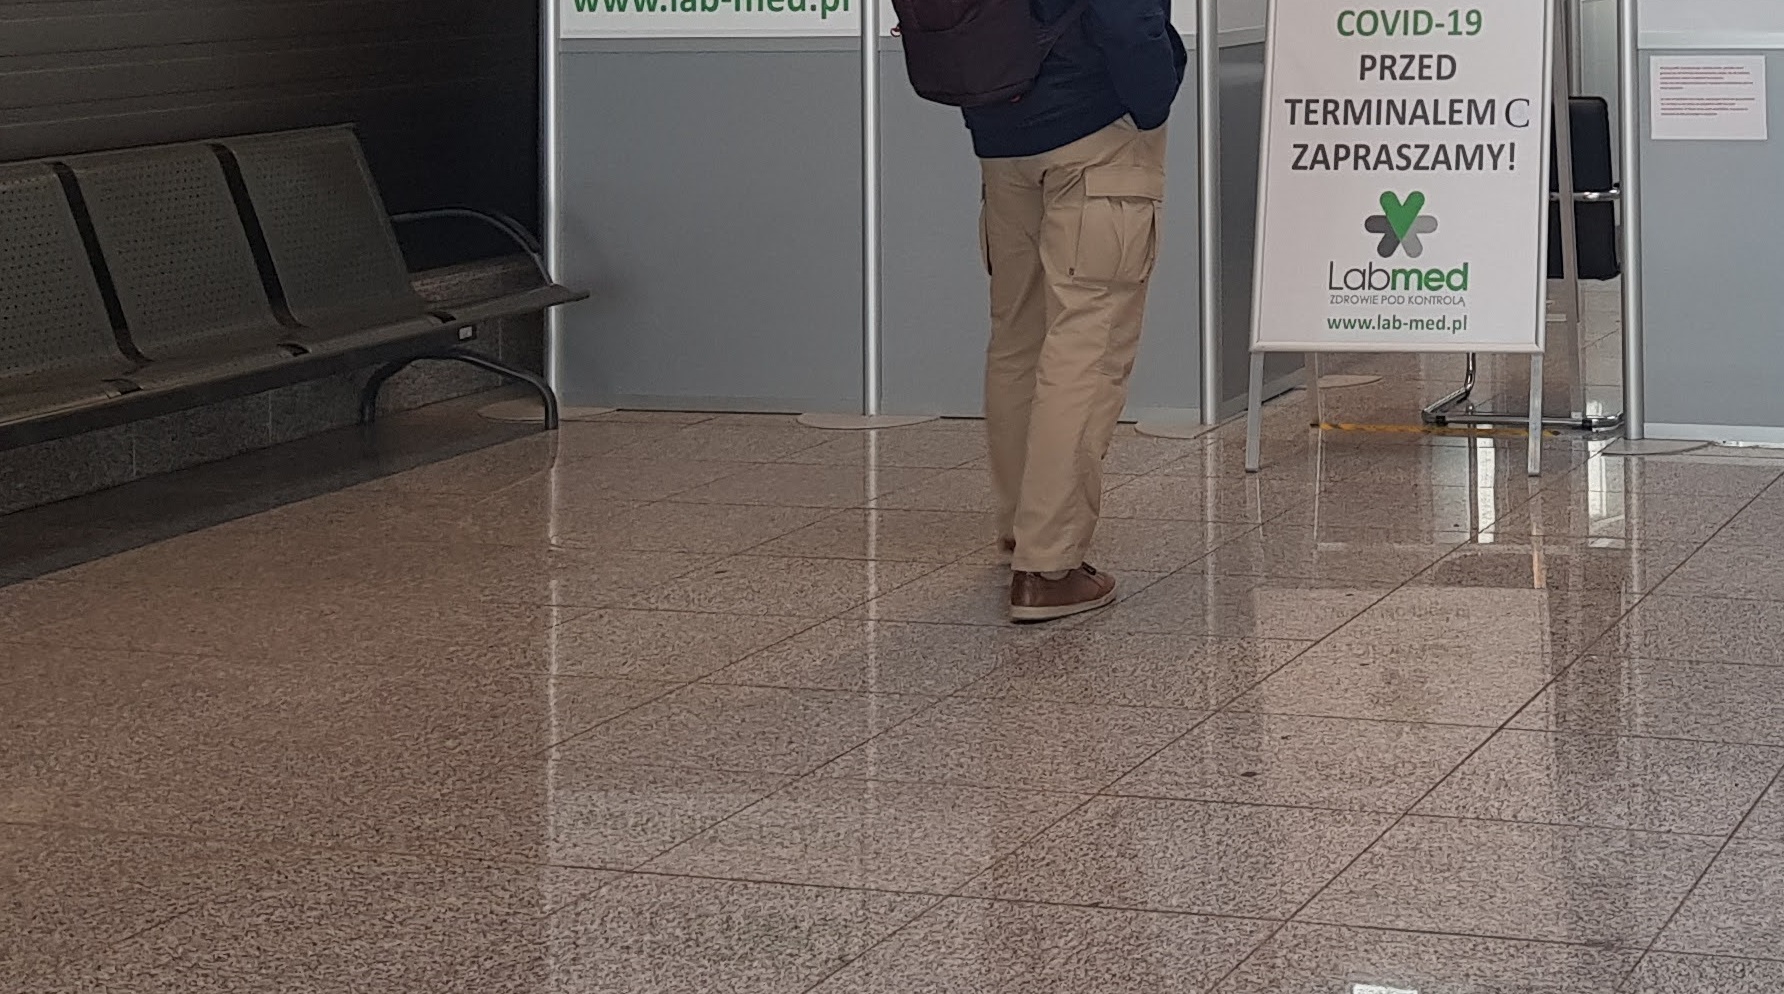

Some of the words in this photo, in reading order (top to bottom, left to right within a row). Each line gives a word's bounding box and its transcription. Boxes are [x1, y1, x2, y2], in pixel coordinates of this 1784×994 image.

[1336, 8, 1483, 37] COVID-19
[1359, 53, 1457, 81] PRZED
[1284, 98, 1496, 126] TERMINALEM
[1504, 97, 1530, 129] C
[1291, 141, 1516, 172] ZAPRASZAMY!
[1328, 260, 1469, 292] Labmed
[1329, 294, 1379, 307] ZDROWIE
[1381, 294, 1406, 307] POD
[1407, 293, 1466, 309] KONTROLĄ
[1326, 314, 1468, 335] www.lab-med.pl
